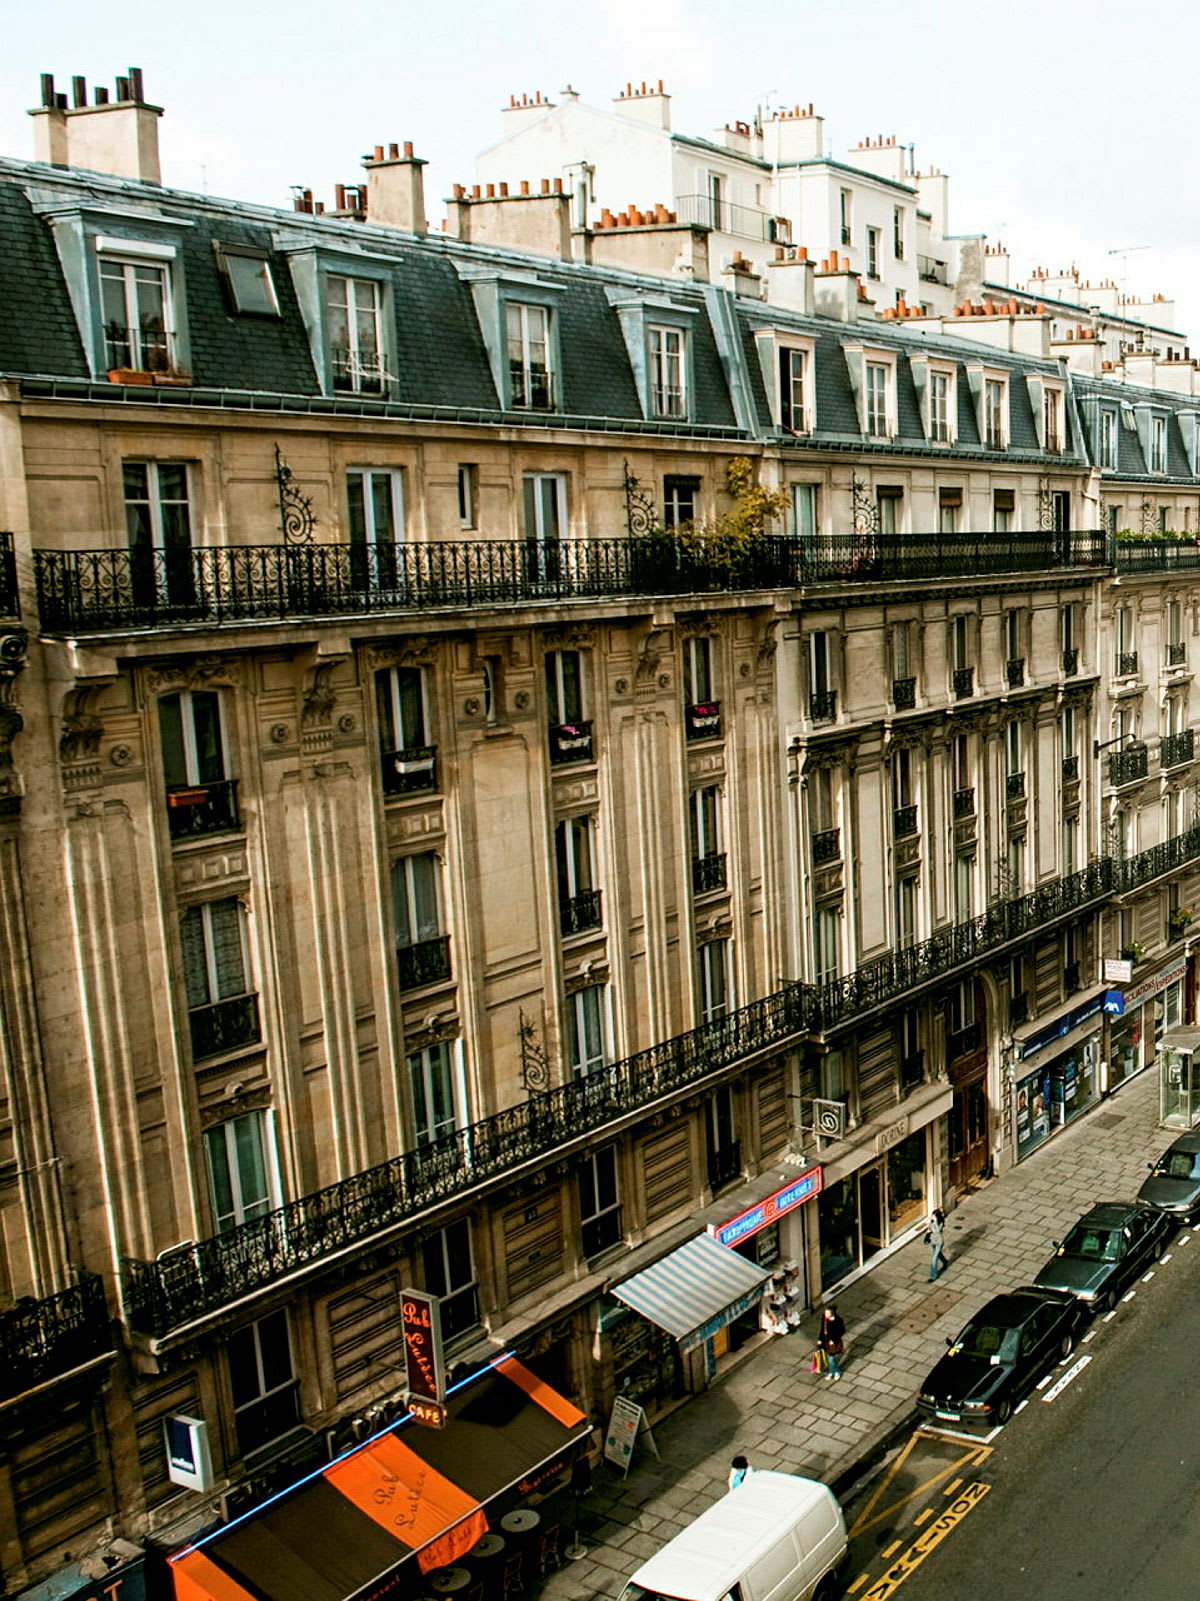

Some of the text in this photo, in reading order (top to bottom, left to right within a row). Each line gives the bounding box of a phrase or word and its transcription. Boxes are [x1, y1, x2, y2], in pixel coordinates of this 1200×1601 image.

[779, 1179, 812, 1208] INTERNET
[402, 1302, 431, 1328] Pub
[372, 1473, 399, 1505] Pub
